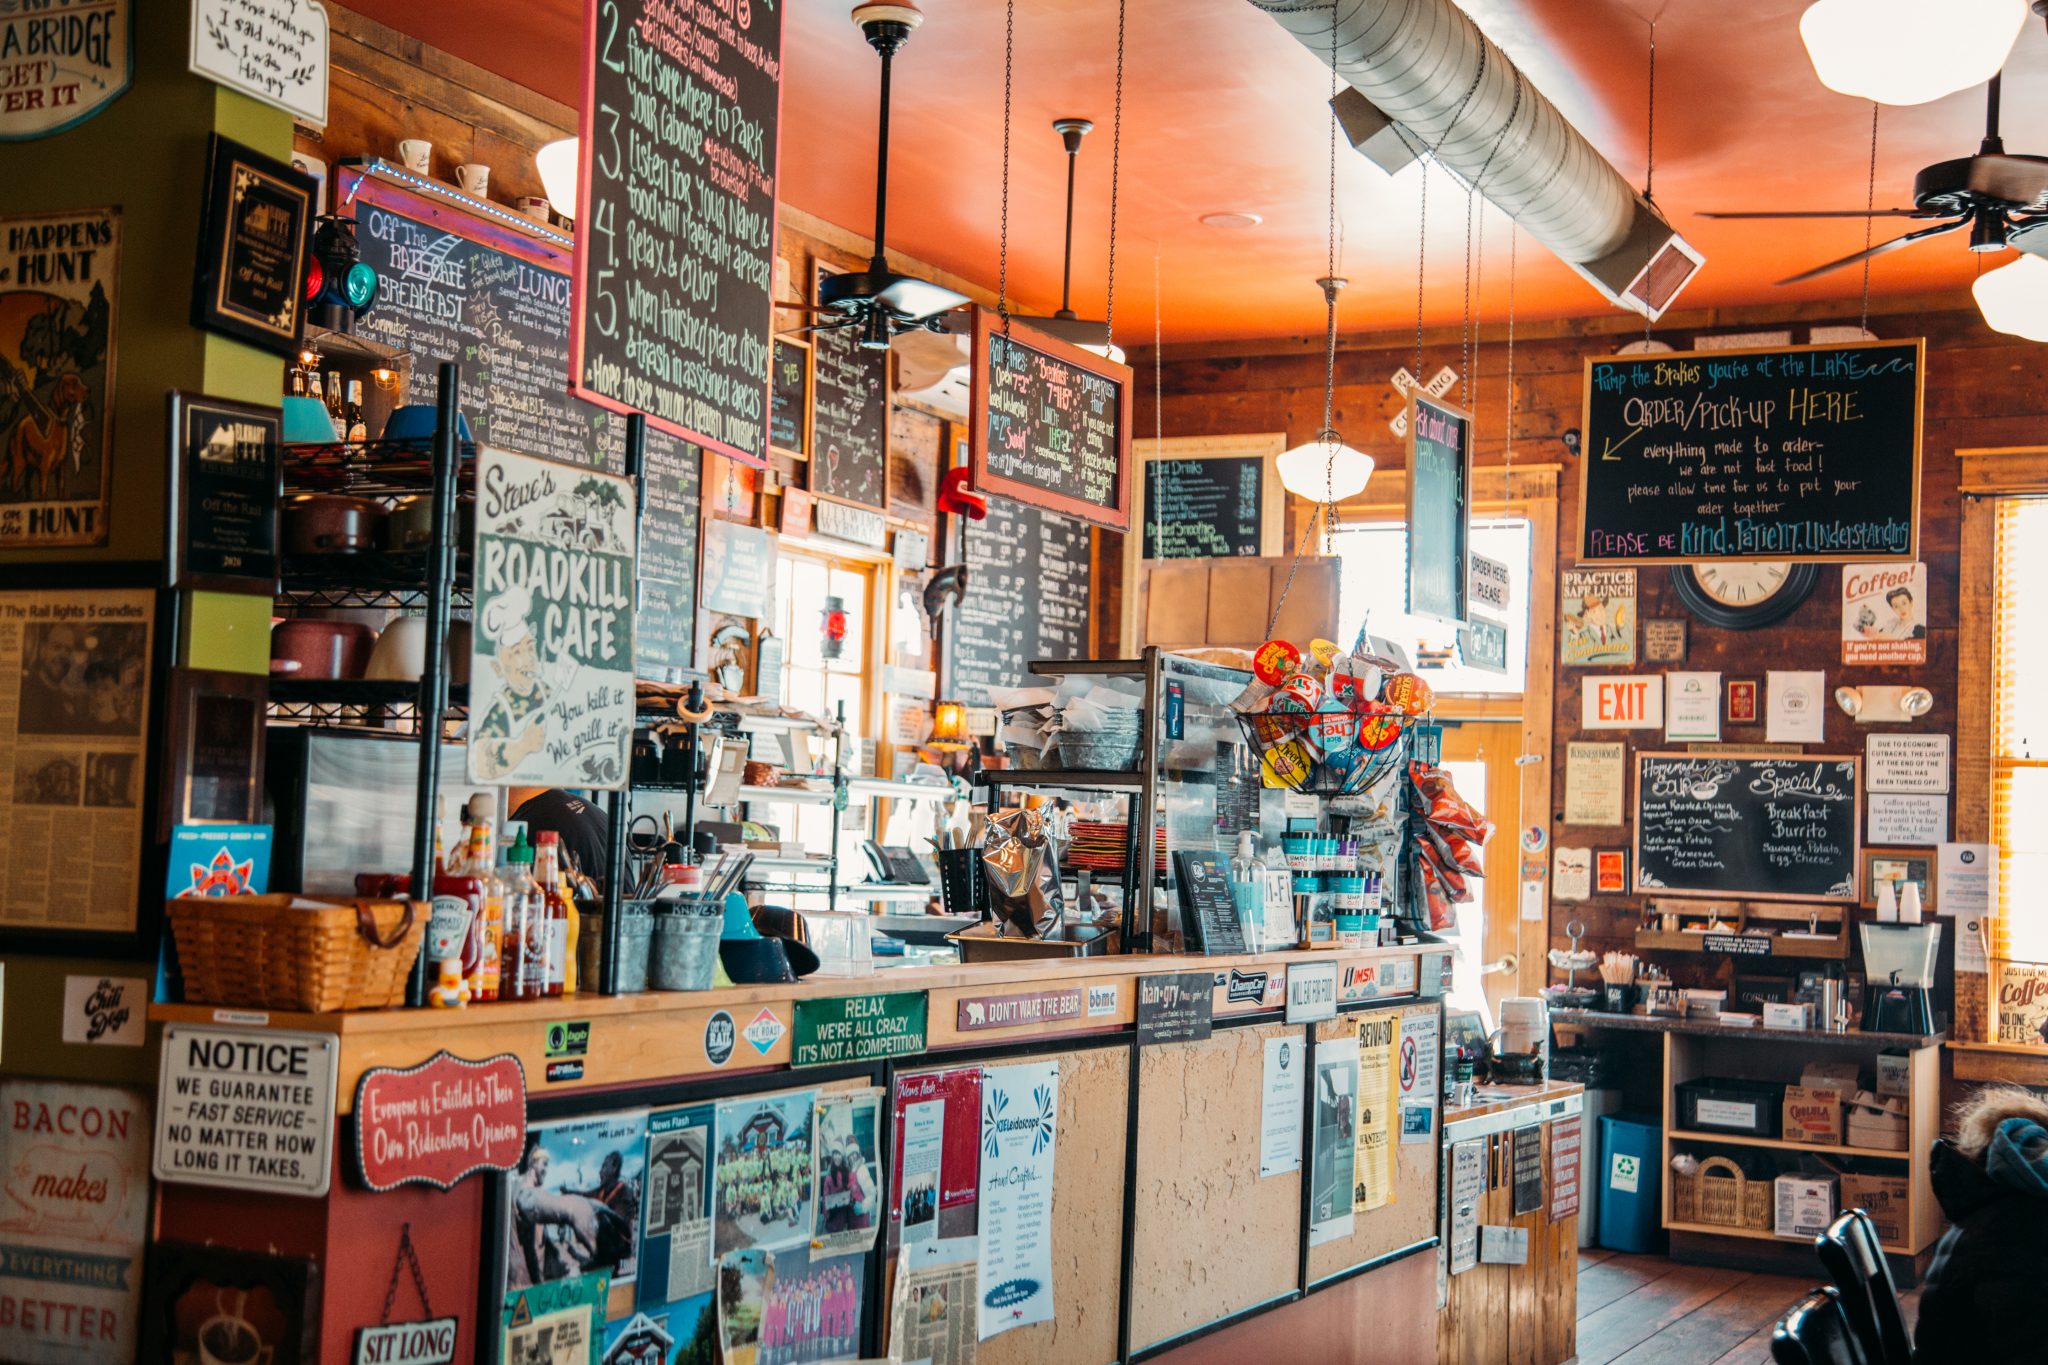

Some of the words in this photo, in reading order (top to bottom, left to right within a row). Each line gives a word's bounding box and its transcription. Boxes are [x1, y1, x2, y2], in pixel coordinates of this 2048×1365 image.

[27, 8, 116, 69] BRIDGE
[266, 33, 302, 61] when
[238, 57, 286, 98] Hangry
[8, 219, 113, 252] HAPPENS
[368, 210, 398, 242] Off
[401, 221, 428, 250] The
[17, 251, 97, 285] HUNT
[627, 219, 666, 278] Relax
[680, 254, 718, 312] enjoy
[378, 273, 467, 323] BREAKFAST
[660, 289, 708, 358] finished
[709, 324, 738, 368] place
[1594, 364, 1626, 395] Pump
[1631, 365, 1650, 388] the
[1654, 361, 1700, 386] Brakes
[1756, 356, 1774, 377] at
[1780, 355, 1804, 376] the
[1643, 441, 1706, 465] everything
[1714, 439, 1743, 456] made
[1754, 435, 1769, 454] to
[1679, 465, 1693, 476] we
[1700, 464, 1716, 476] are
[1723, 460, 1742, 475] not
[1756, 457, 1776, 474] fast
[483, 464, 556, 520] Steve's
[1627, 483, 1661, 503] please
[1668, 482, 1696, 496] allow
[1704, 479, 1726, 494] time
[1732, 478, 1750, 494] for
[1757, 482, 1768, 492] us
[1776, 477, 1790, 492] to
[1799, 476, 1823, 497] put
[1834, 479, 1863, 496] your
[27, 506, 98, 535] HUNT
[1697, 503, 1725, 515] order
[1733, 502, 1786, 518] together
[1658, 533, 1676, 549] BE
[484, 539, 629, 612] ROADKILL
[1472, 554, 1491, 577] ORDER
[1492, 560, 1508, 586] HERE
[1565, 571, 1634, 586] PRACTICE
[1845, 565, 1917, 600] Coffee!
[1477, 580, 1501, 604] PLEASE
[1564, 585, 1592, 598] SAFE
[1595, 585, 1634, 598] LUNCH
[544, 603, 617, 662] CAFE
[587, 687, 610, 709] kill
[613, 687, 625, 706] it
[1598, 682, 1648, 721] EXIT
[546, 741, 572, 765] We
[573, 722, 603, 748] grill
[1642, 758, 1706, 779] Homemade
[1750, 763, 1823, 798] Special
[1764, 802, 1831, 820] Breakfast
[1772, 820, 1827, 838] Burrito
[1230, 978, 1266, 993] ChampCar
[1353, 967, 1375, 984] IMSA
[84, 987, 122, 1018] Chili
[1304, 979, 1312, 1005] EAT
[1322, 977, 1333, 1003] FOOD
[845, 997, 886, 1019] RELAX
[989, 1002, 1018, 1022] DON'T
[1019, 999, 1042, 1018] WAKE
[1043, 997, 1059, 1016] THE
[2000, 1013, 2010, 1025] NO
[2012, 1014, 2026, 1026] ONE
[86, 1010, 130, 1042] Dogs
[816, 1021, 853, 1041] WE'RE
[854, 1019, 874, 1037] ALL
[876, 1016, 909, 1034] CRAZY
[1359, 1021, 1392, 1049] REWARD
[1408, 1024, 1418, 1032] PETS
[1418, 1020, 1434, 1031] ALLOWED
[2000, 1026, 2026, 1040] GETS
[189, 1038, 309, 1076] NOTICE
[798, 1044, 818, 1063] IT'S
[820, 1041, 843, 1060] NOT
[845, 1041, 854, 1058] A
[856, 1033, 923, 1056] COMPETITION
[177, 1077, 201, 1096] WE
[210, 1079, 313, 1106] GUARANTEE
[371, 1088, 418, 1132] Everyone
[420, 1095, 430, 1116] is
[433, 1080, 474, 1115] Entitled
[475, 1081, 486, 1106] to
[484, 1072, 514, 1108] Their
[13, 1100, 131, 1141] BACON
[188, 1102, 229, 1122] FAST
[233, 1105, 306, 1129] SERVICE
[168, 1125, 191, 1143] NO
[200, 1127, 268, 1150] MATTER
[276, 1134, 316, 1155] HOW
[374, 1126, 405, 1165] Own
[406, 1117, 470, 1160] Ridiculous
[473, 1112, 518, 1160] Opinion
[174, 1149, 219, 1170] LONG
[226, 1154, 241, 1173] IT
[32, 1163, 109, 1202] makes
[9, 1255, 118, 1283] EVERYTHING
[0, 1296, 118, 1343] BETTER
[364, 1332, 397, 1365] SIT
[400, 1327, 453, 1361] LONG
